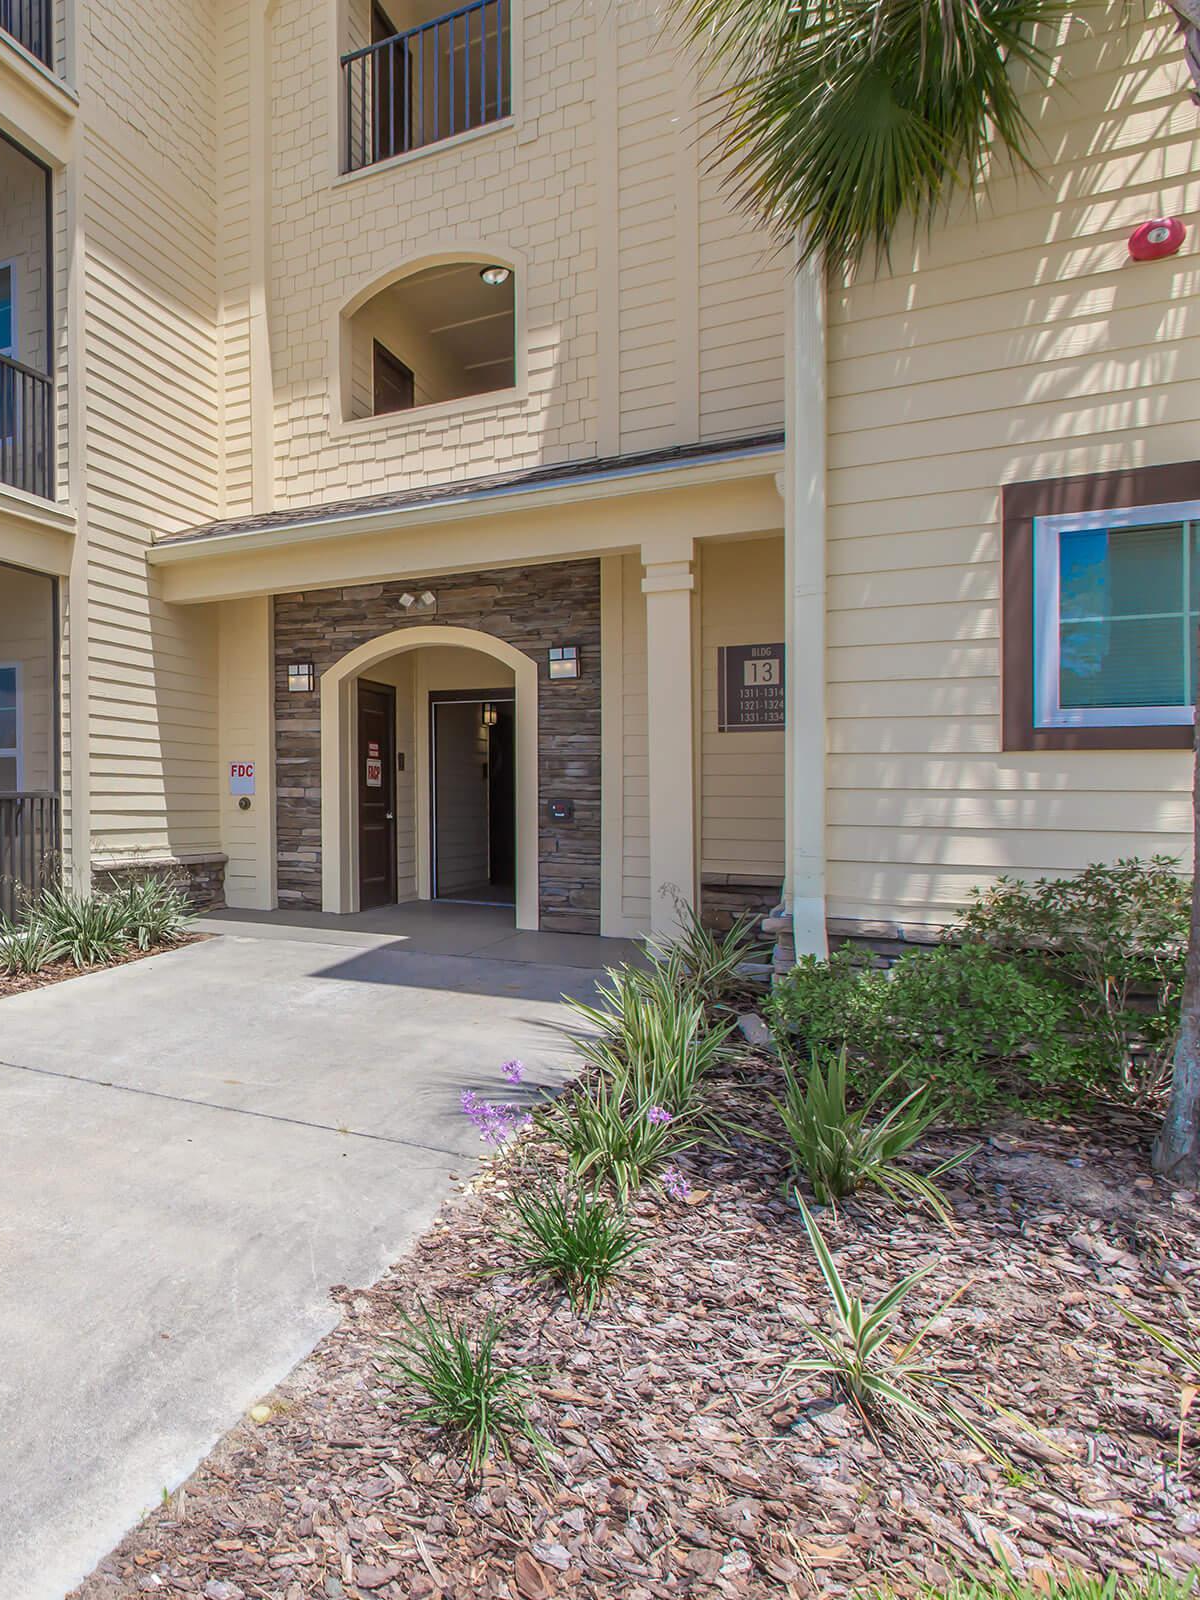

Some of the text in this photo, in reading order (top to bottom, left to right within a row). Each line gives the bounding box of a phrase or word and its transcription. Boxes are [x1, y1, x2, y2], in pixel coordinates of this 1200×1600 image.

[751, 647, 772, 657] BLDG
[751, 662, 773, 682] 13
[231, 764, 254, 777] FDC
